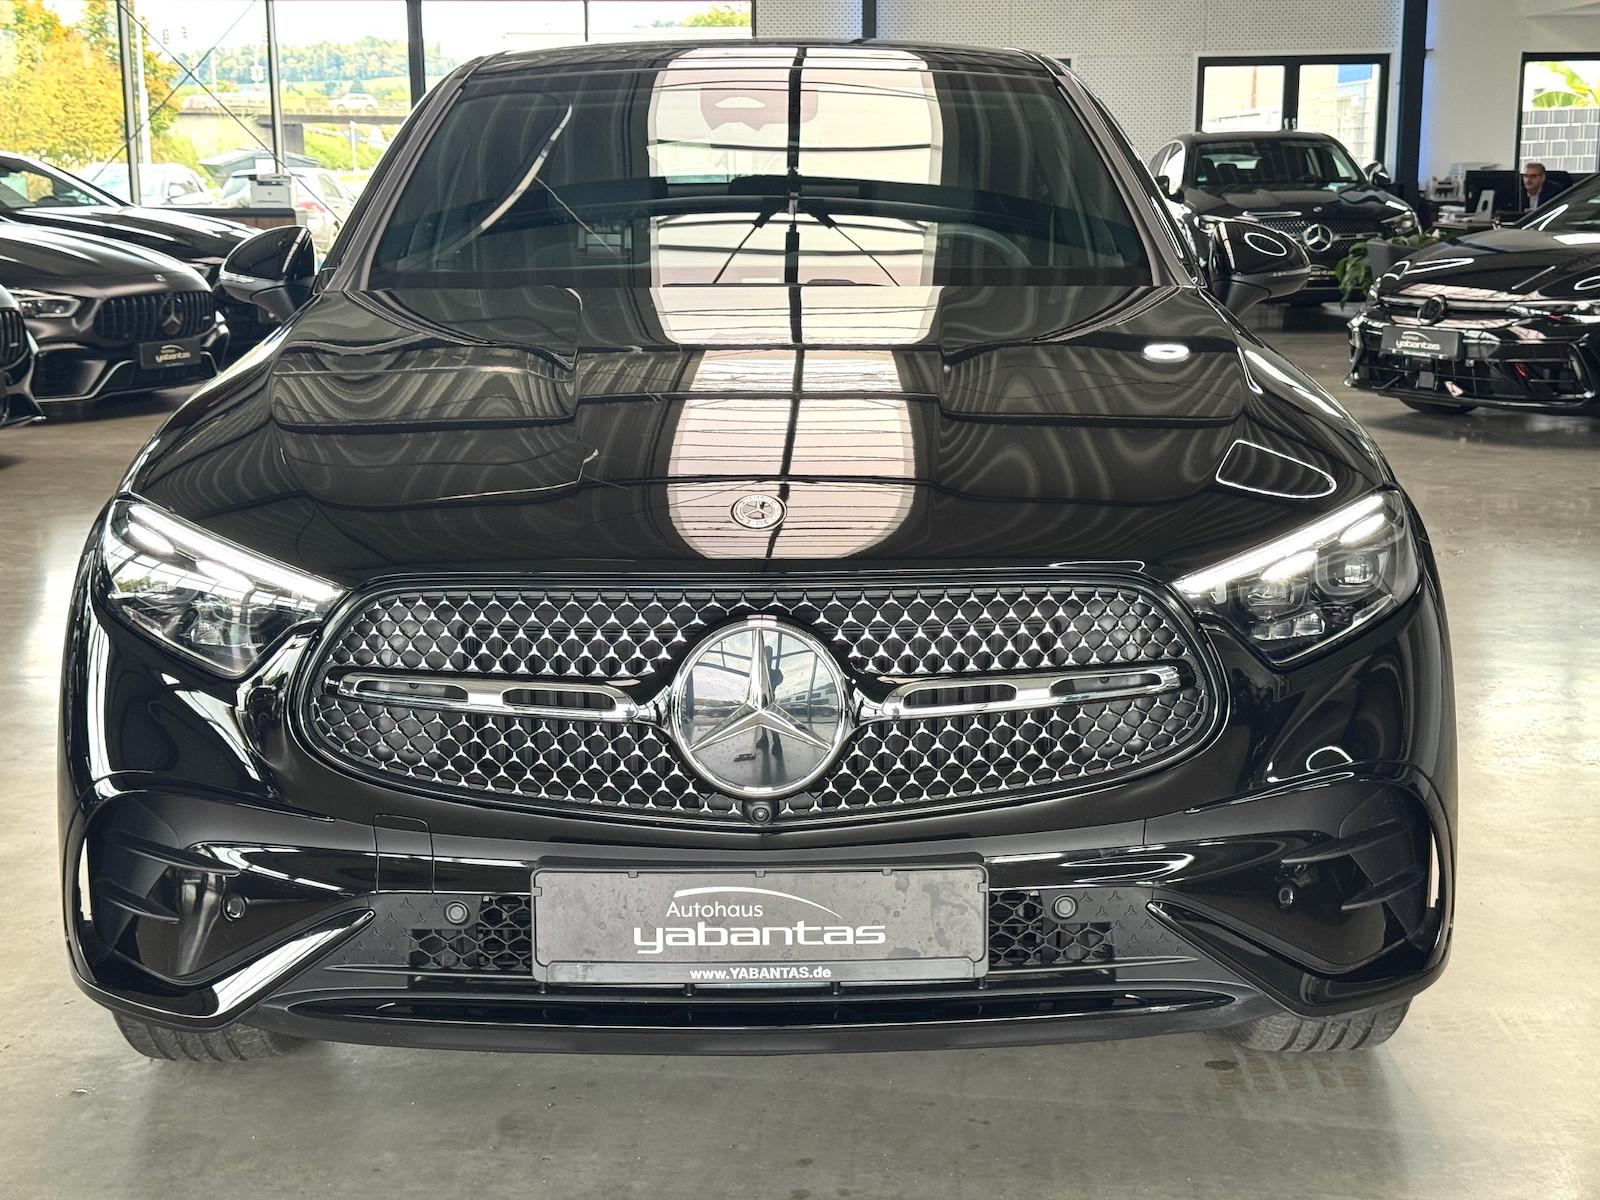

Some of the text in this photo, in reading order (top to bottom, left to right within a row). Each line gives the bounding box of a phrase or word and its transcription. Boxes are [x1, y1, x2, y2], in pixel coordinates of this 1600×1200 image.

[665, 901, 764, 918] Autohaus
[633, 920, 886, 955] yabantas
[689, 966, 832, 980] www.YABANTAS.de
